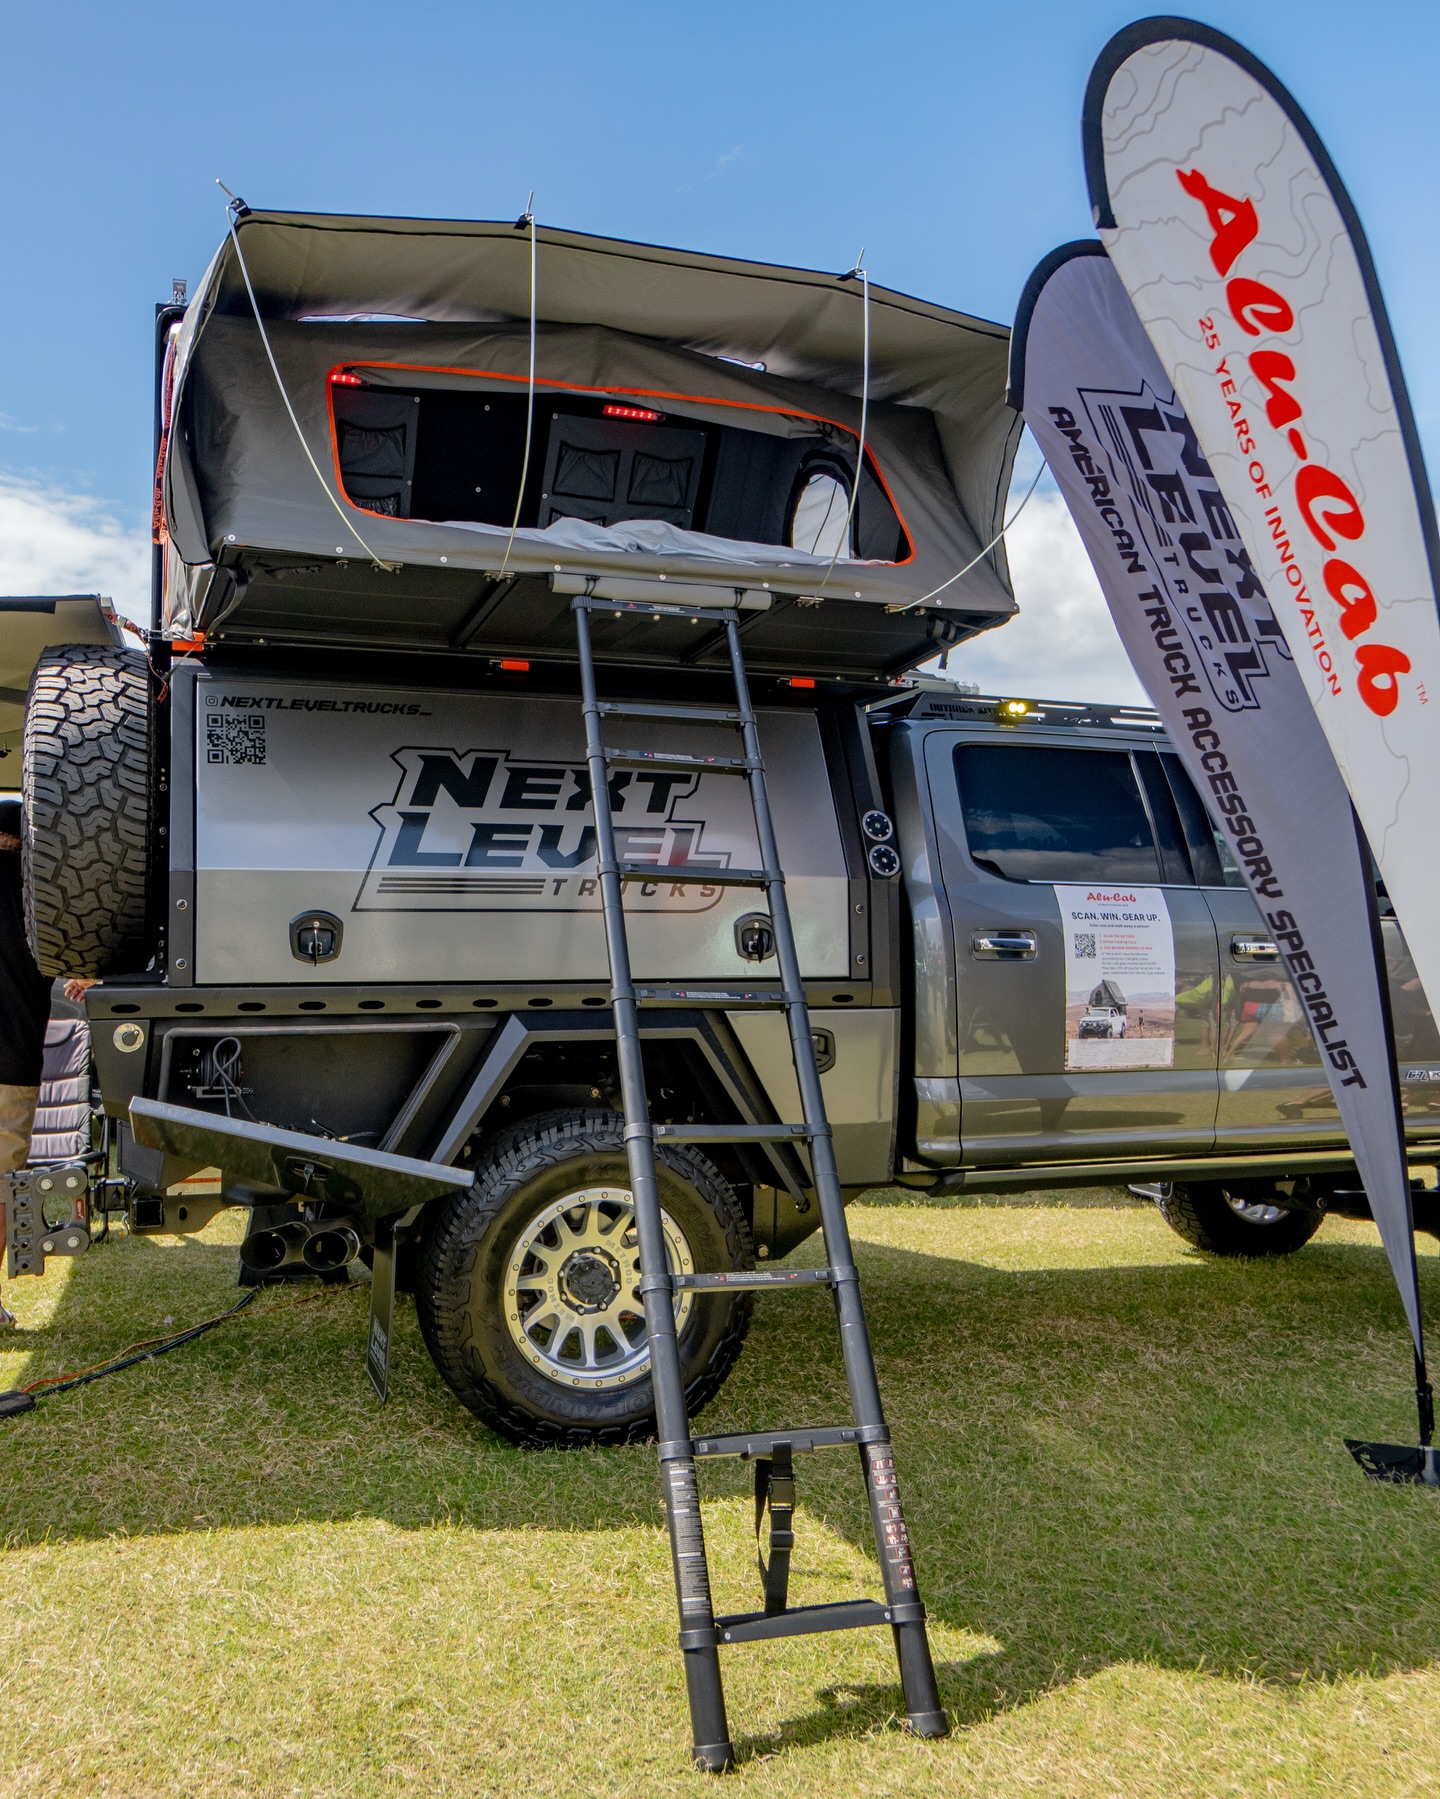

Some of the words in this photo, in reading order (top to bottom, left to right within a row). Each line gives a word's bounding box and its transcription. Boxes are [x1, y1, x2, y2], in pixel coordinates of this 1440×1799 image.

[1175, 168, 1411, 717] Alu-Cab
[1198, 317, 1221, 350] 25
[1216, 357, 1256, 455] YEARS
[1249, 461, 1273, 499] OF
[1264, 506, 1342, 697] INNOVATION
[1119, 402, 1260, 702] LEVEL
[1163, 553, 1239, 704] TRUCKS
[220, 696, 432, 716] NEXTLEVELTRUCKS_
[1048, 407, 1148, 574] AMERICAN
[1138, 584, 1202, 699] TRUCK
[1182, 707, 1284, 899] ACCESSORY
[1267, 909, 1367, 1090] SPECIALIST
[409, 754, 692, 814] NEXT
[387, 811, 722, 869] LEVEL
[552, 878, 716, 898] TRCKS
[1071, 912, 1099, 920] SCAN.
[1101, 912, 1121, 920] WIN.
[1122, 913, 1145, 921] GEAR
[1087, 892, 1137, 903] Alu-Cab
[586, 1162, 722, 1270] YOHAMA
[604, 1239, 633, 1285] METHOD
[546, 1276, 576, 1323] METHOD
[489, 1345, 653, 1420] OLANDAR
